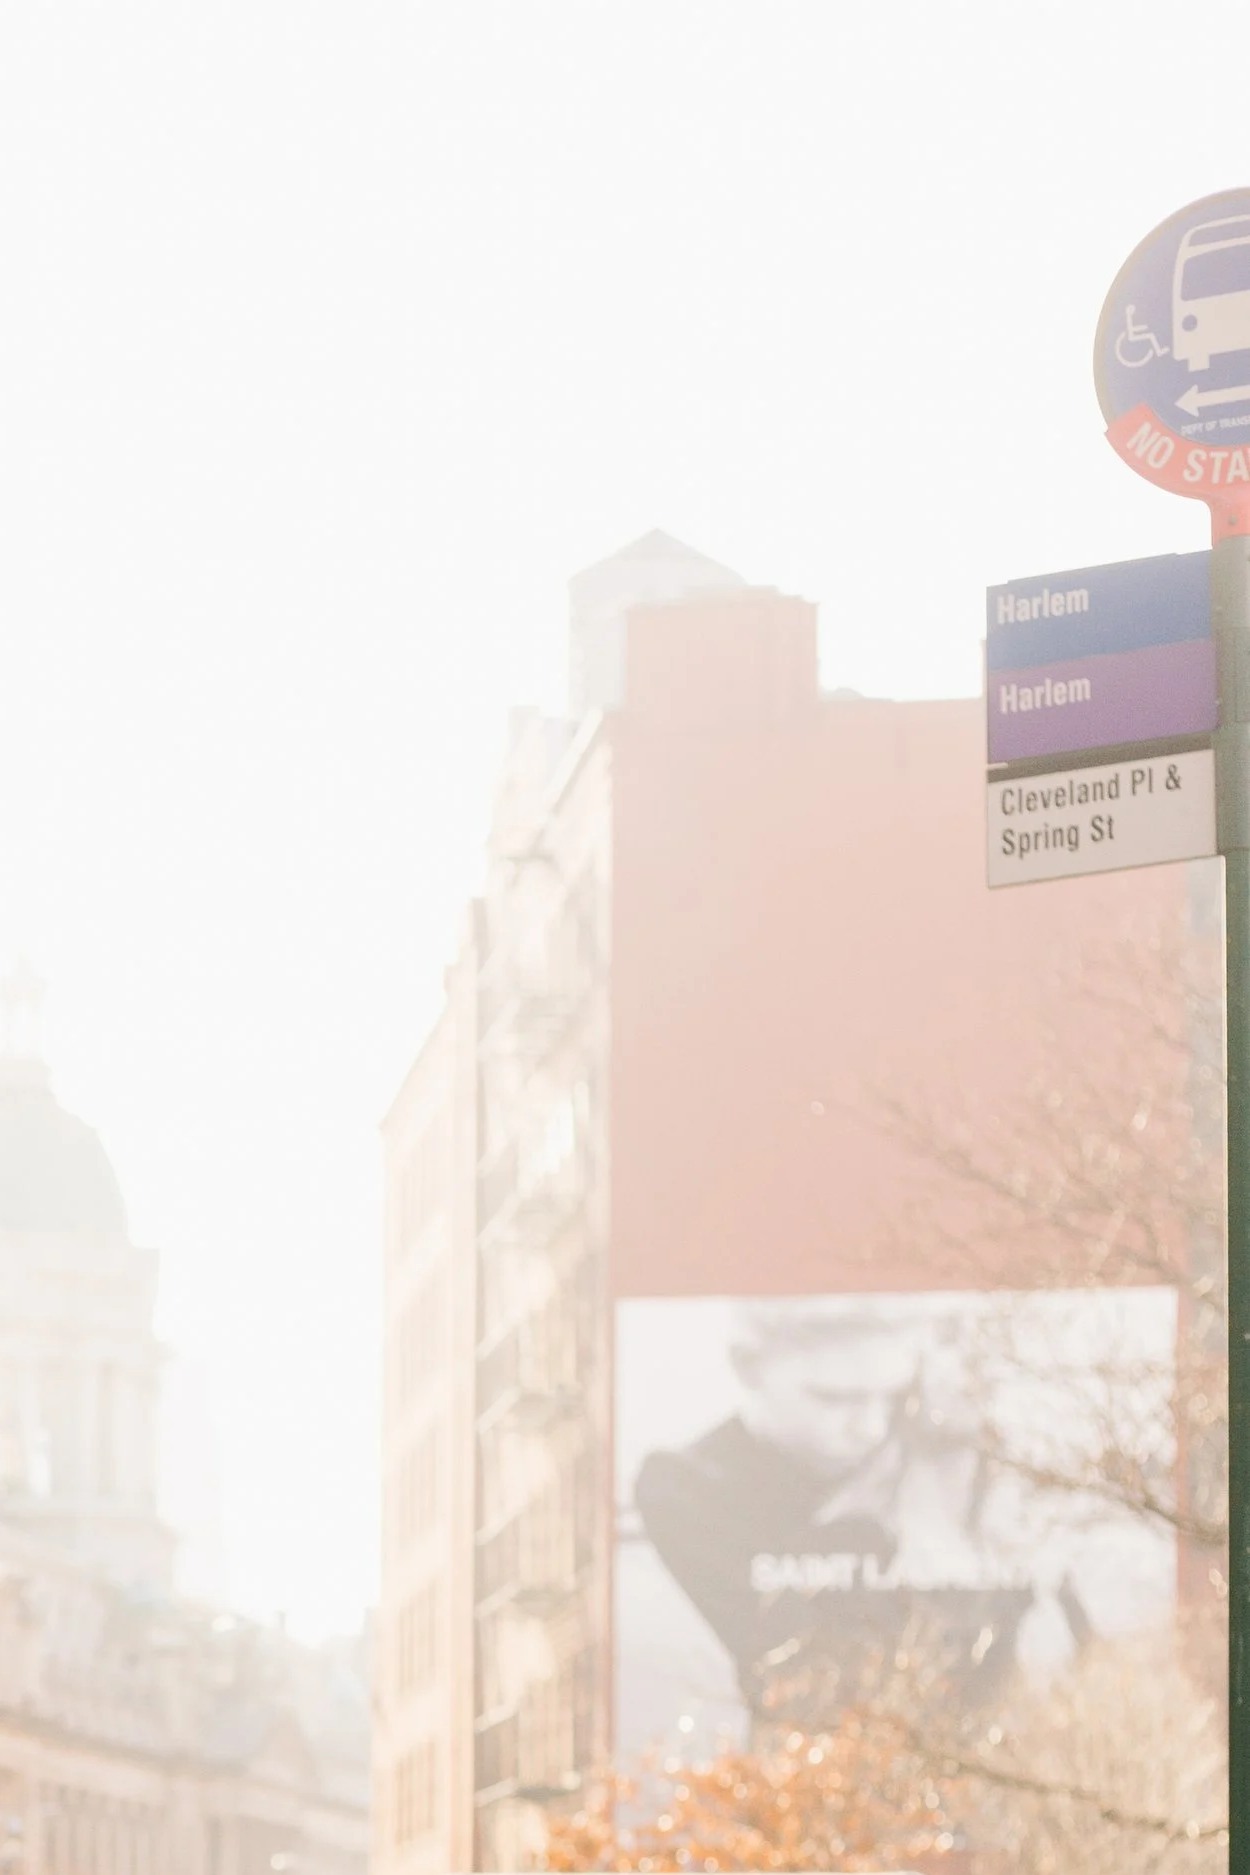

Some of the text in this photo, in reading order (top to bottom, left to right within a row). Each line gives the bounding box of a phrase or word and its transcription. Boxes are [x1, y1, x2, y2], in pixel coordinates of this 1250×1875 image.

[1126, 422, 1250, 485] NO STA
[997, 587, 1090, 625] Harlem
[999, 676, 1092, 715] Harlem
[1001, 763, 1182, 816] Cleveland Pl &
[1001, 814, 1115, 860] Spring St
